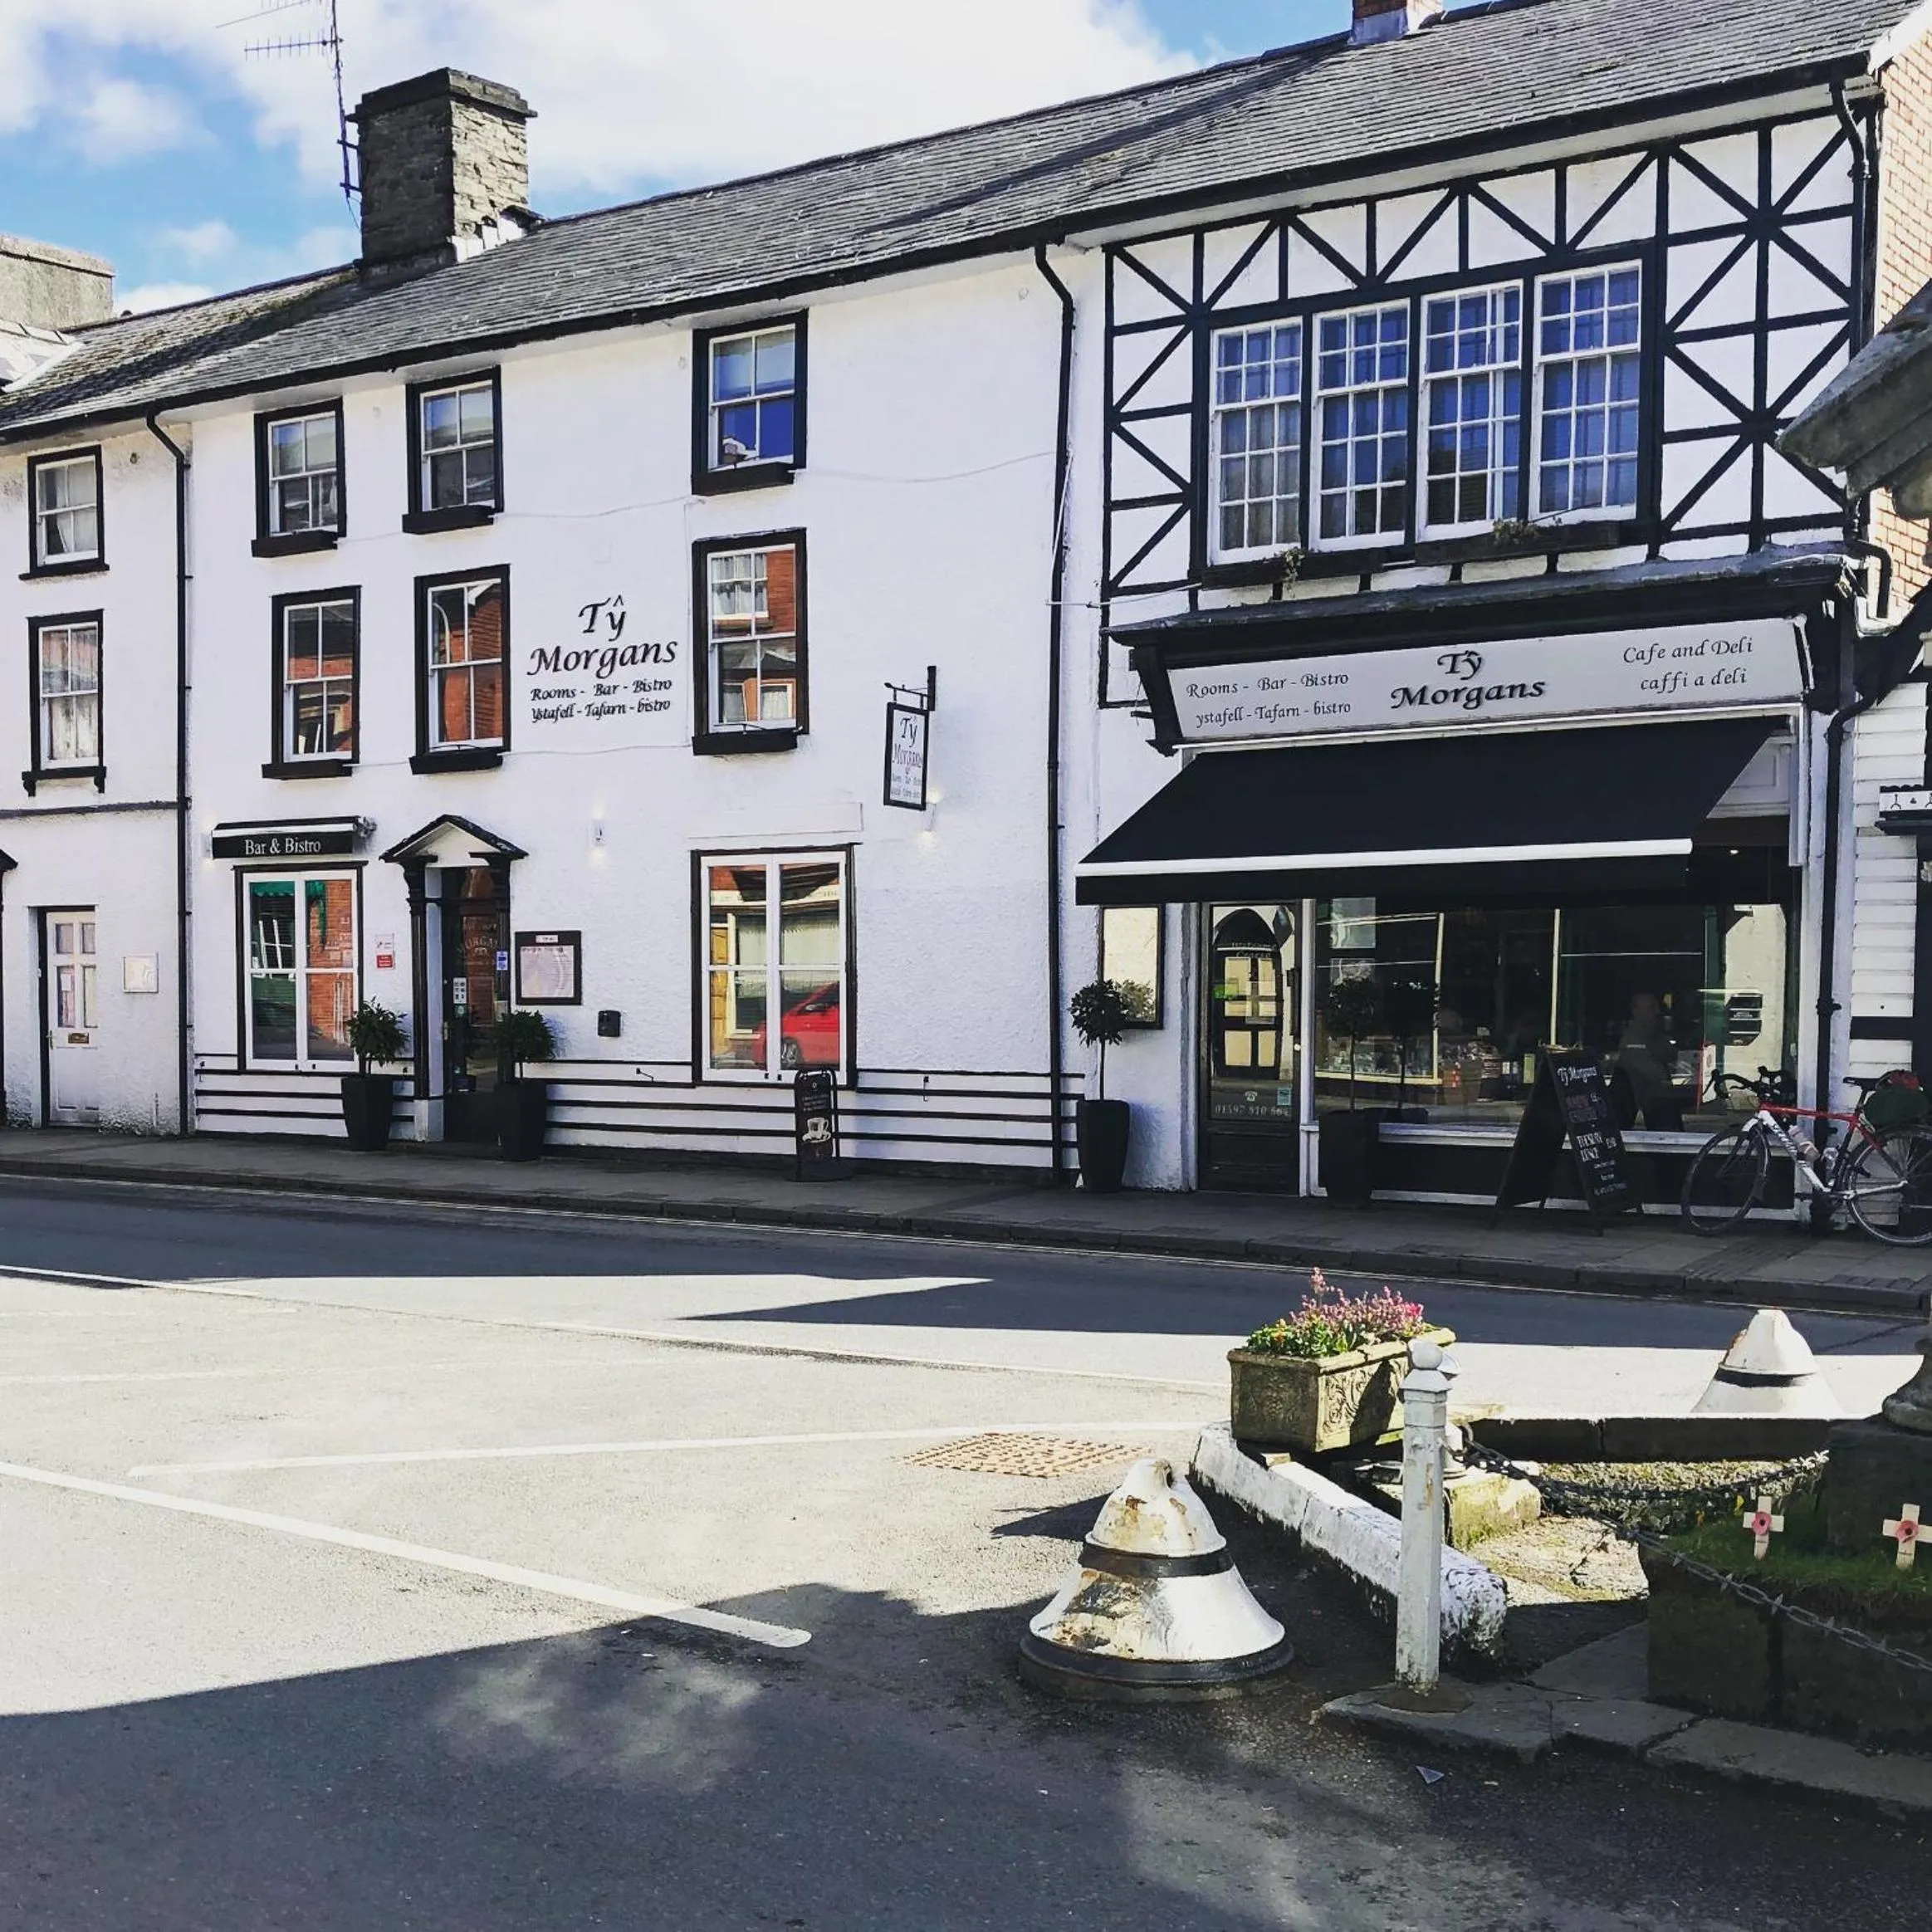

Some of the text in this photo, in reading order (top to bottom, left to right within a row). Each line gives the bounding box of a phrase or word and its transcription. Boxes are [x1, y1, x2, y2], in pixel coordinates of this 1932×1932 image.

[526, 641, 677, 680] Morgans
[1623, 636, 1753, 665] Cafe and Deli
[531, 687, 576, 702] Rooms
[593, 682, 620, 697] Bar
[632, 677, 673, 694] Bistro
[1186, 683, 1238, 698] Rooms
[1258, 677, 1287, 691] Bar
[1300, 673, 1349, 687] Bistro
[1641, 667, 1747, 694] caffi a deli
[1391, 682, 1545, 710] Morgans
[584, 701, 627, 721] Tafarn
[638, 697, 672, 713] bistro
[1254, 704, 1300, 723] Tafarn
[1313, 700, 1352, 716] bistro
[245, 836, 322, 855] Bar & Bistro
